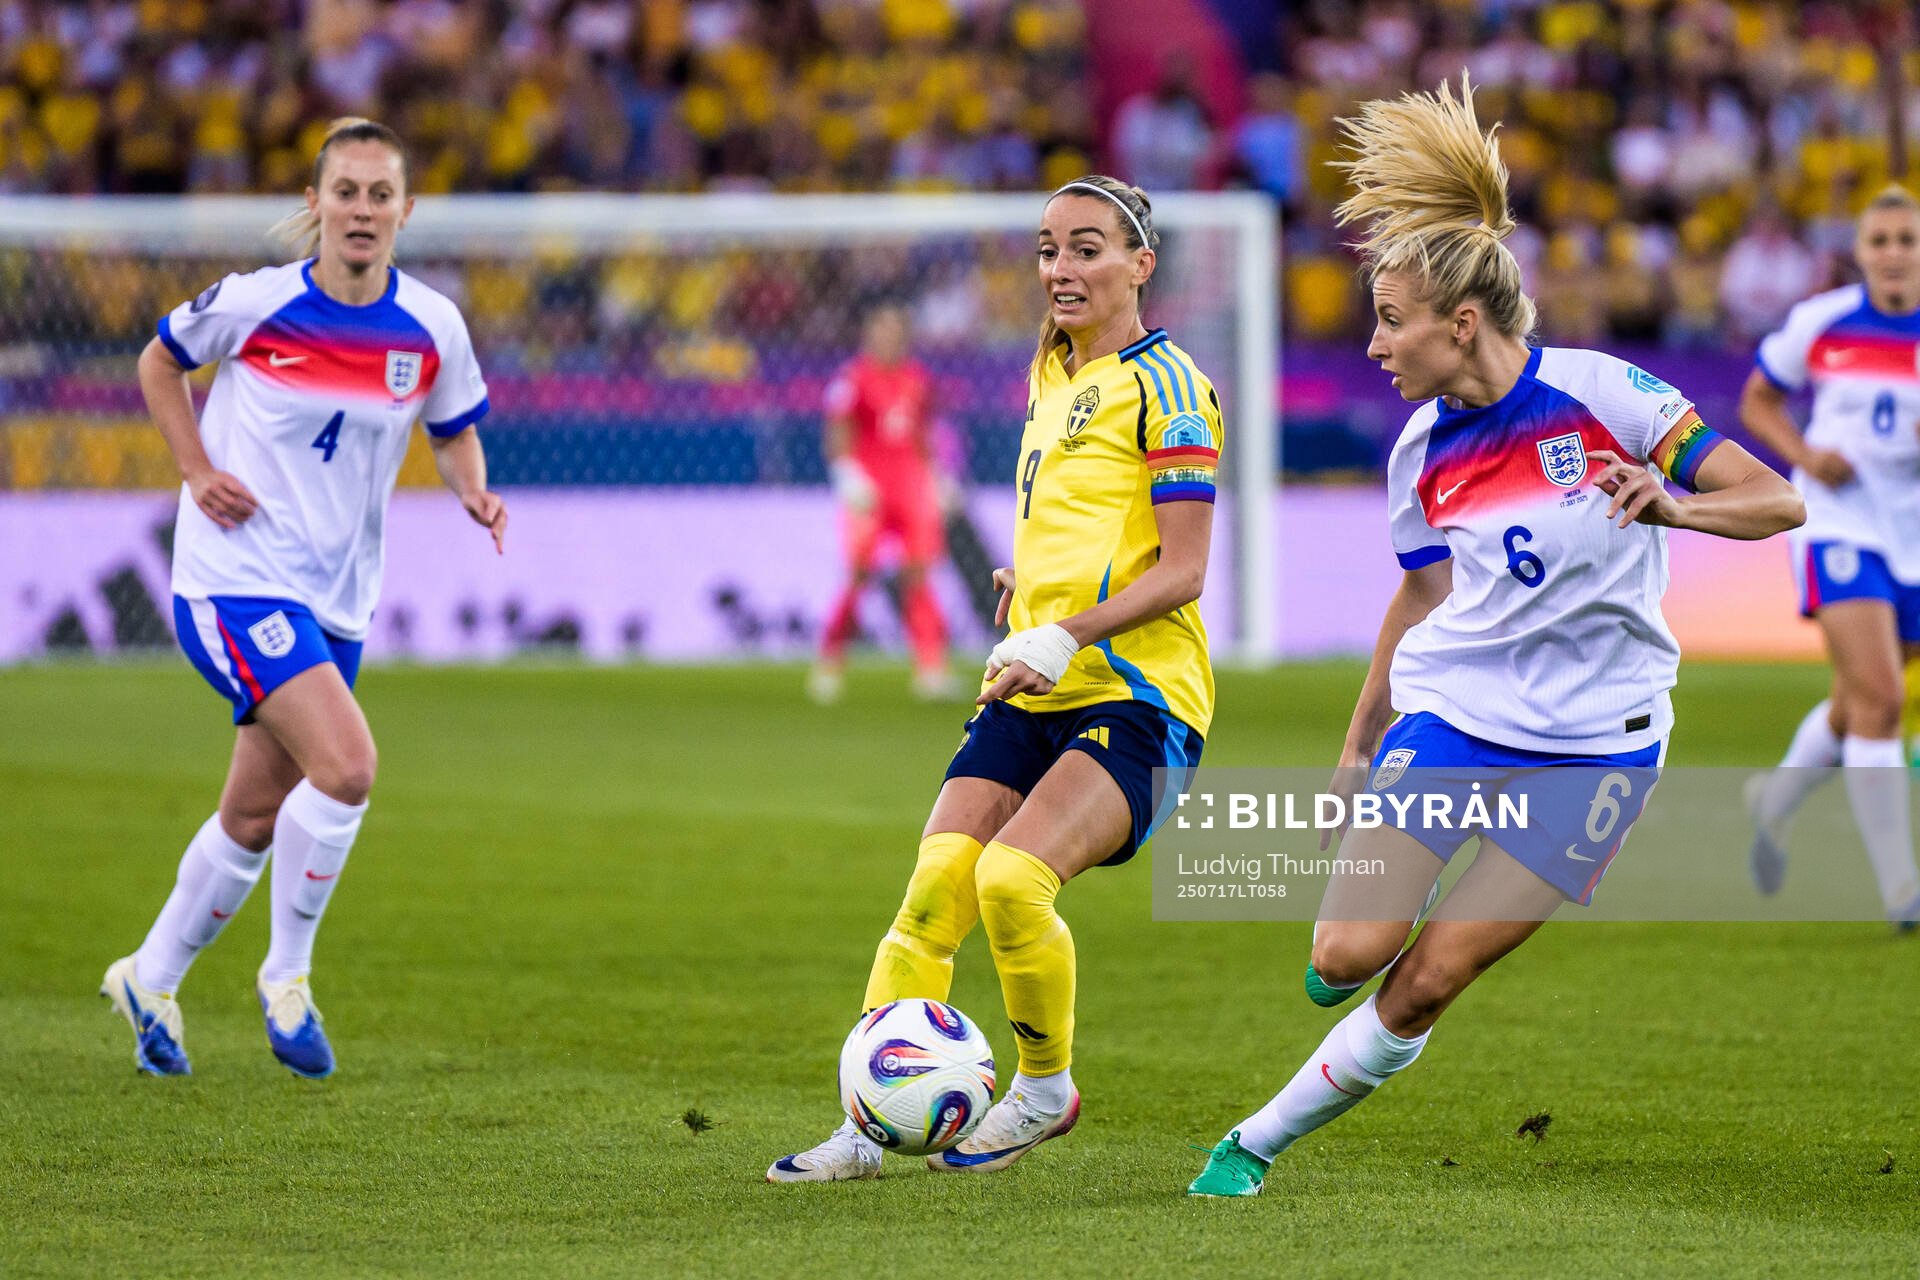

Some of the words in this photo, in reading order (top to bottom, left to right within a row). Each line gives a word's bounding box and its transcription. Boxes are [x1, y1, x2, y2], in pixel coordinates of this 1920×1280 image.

[312, 410, 345, 462] 4
[1021, 449, 1042, 520] 9
[1502, 525, 1546, 588] 6
[1584, 772, 1632, 844] 6
